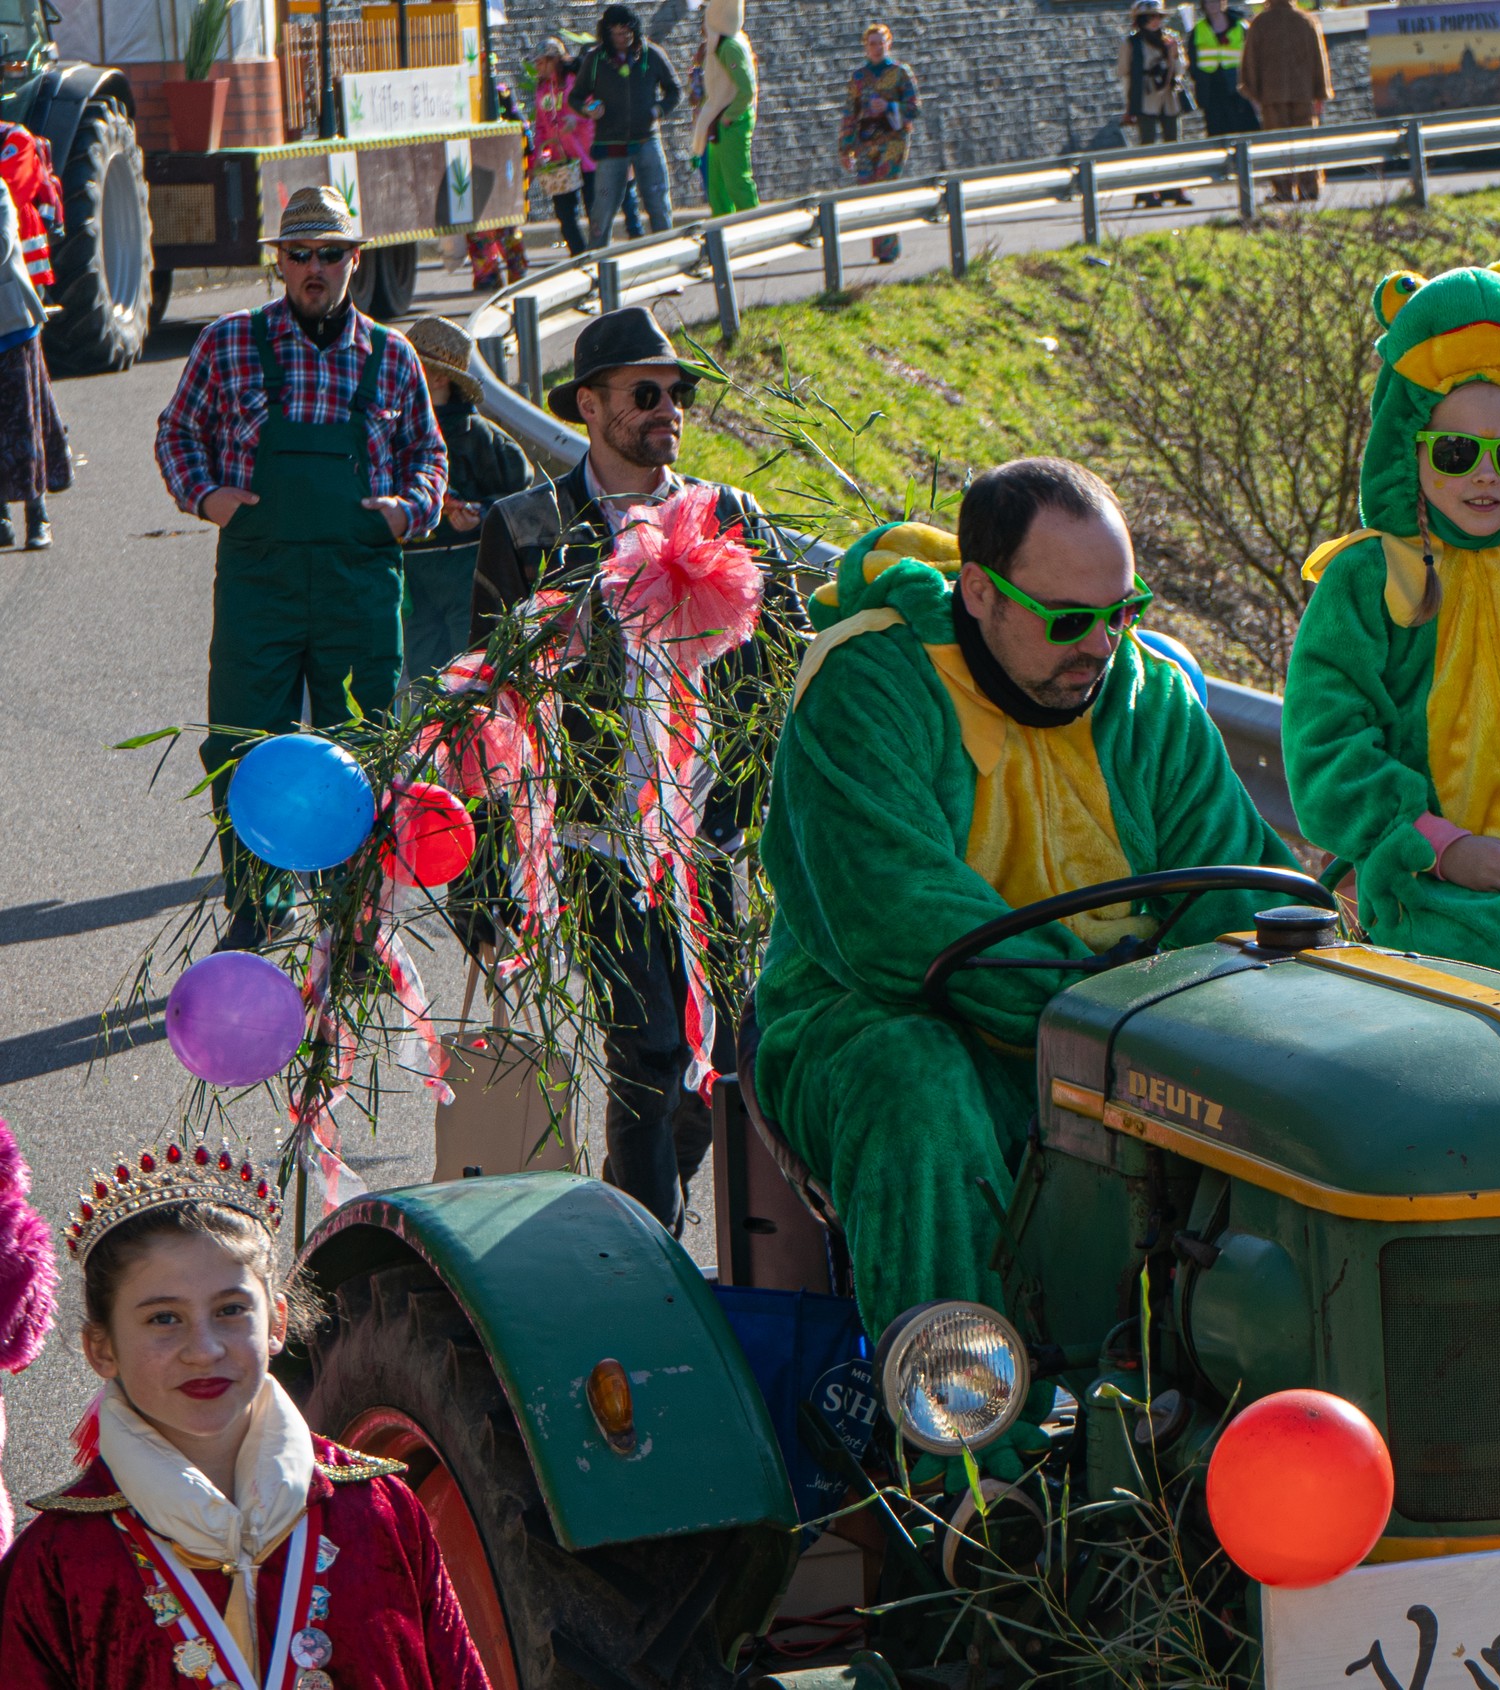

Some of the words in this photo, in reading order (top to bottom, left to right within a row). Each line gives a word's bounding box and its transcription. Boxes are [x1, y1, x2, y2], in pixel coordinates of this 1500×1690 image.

[1398, 15, 1435, 35] MARY
[1440, 12, 1499, 32] POPPINS
[1129, 1070, 1222, 1131] DEUTZ
